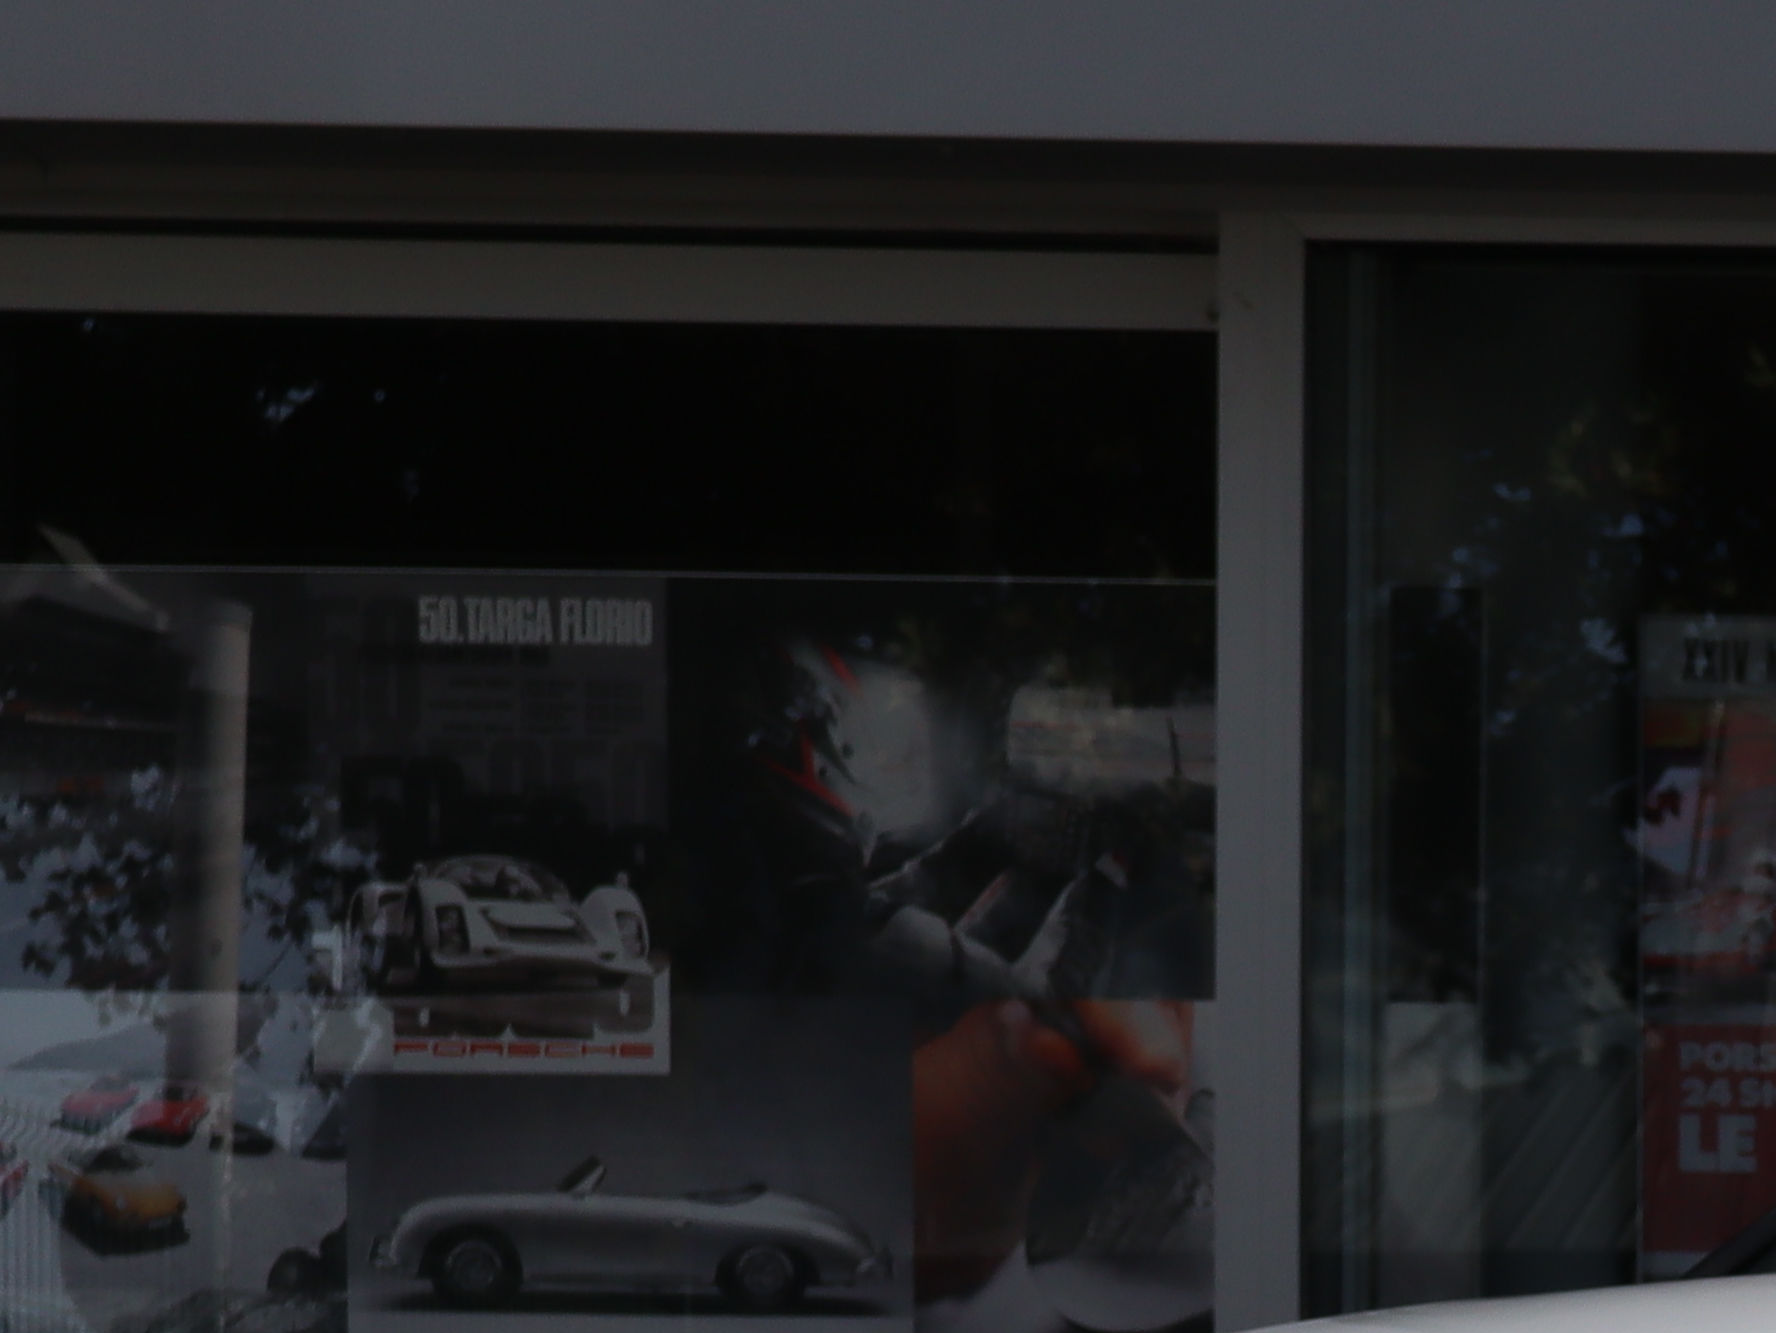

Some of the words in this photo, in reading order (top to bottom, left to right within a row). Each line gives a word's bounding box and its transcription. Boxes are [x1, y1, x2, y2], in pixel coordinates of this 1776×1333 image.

[559, 597, 653, 646] FLORIO
[1681, 637, 1749, 683] XXIV
[1680, 1077, 1732, 1108] 24
[1679, 1115, 1756, 1173] LE
